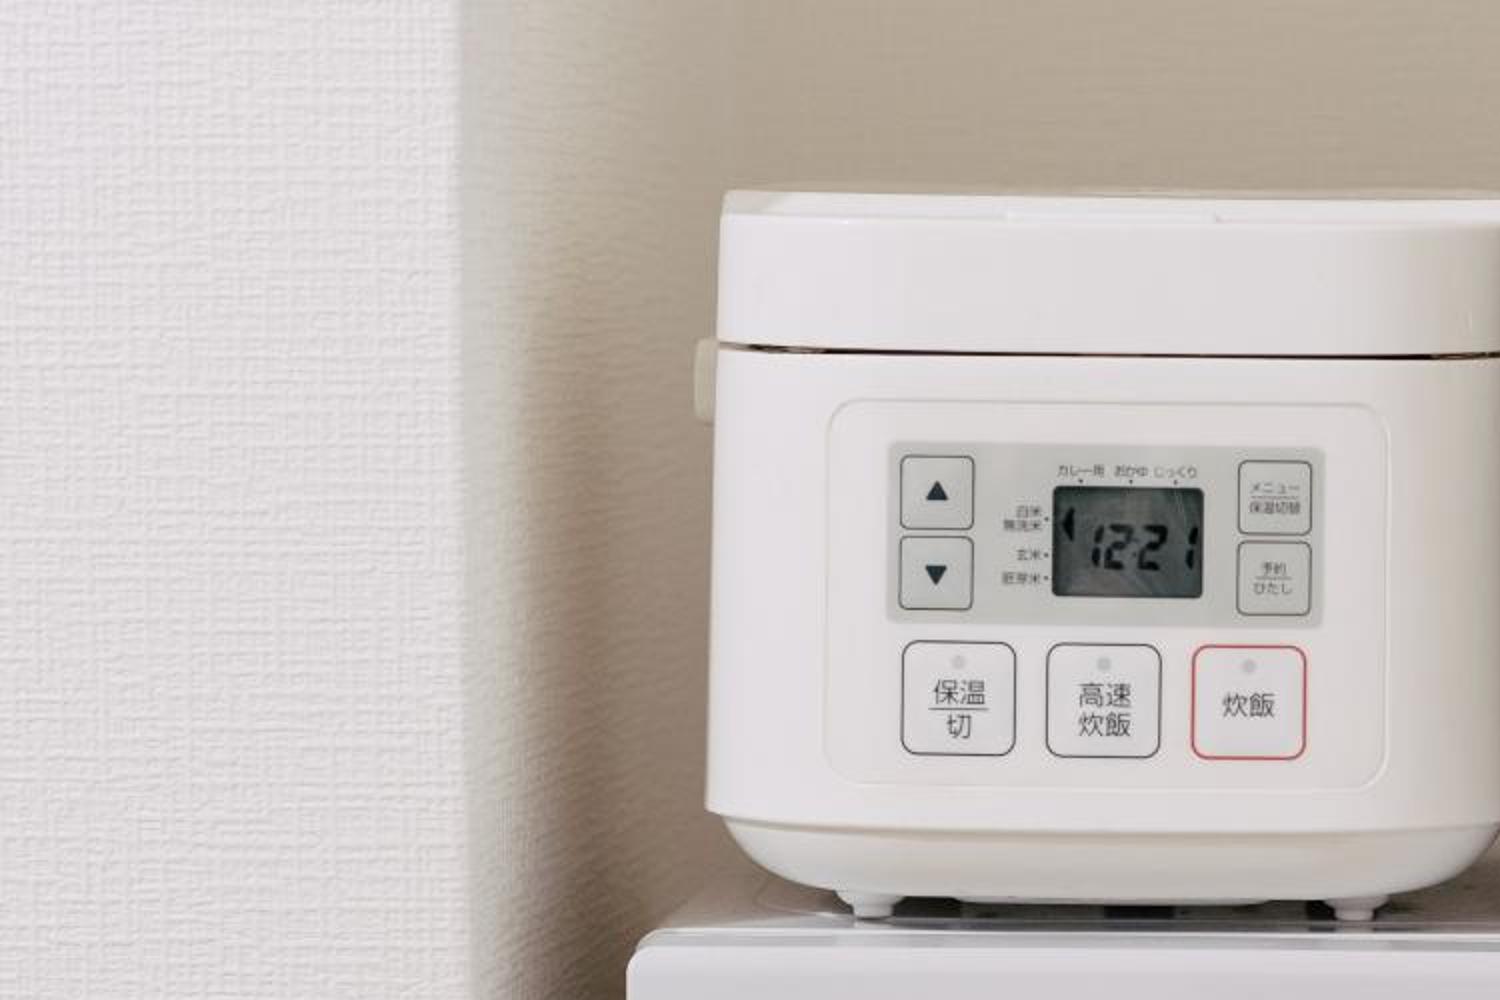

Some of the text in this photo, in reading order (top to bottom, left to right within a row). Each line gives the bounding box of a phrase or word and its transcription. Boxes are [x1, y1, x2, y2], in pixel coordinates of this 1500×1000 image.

[933, 679, 987, 706] 保温
[1078, 683, 1132, 708] 高速
[1222, 693, 1275, 718] 炊飯
[946, 714, 973, 739] 切
[1078, 713, 1131, 738] 炊飯
